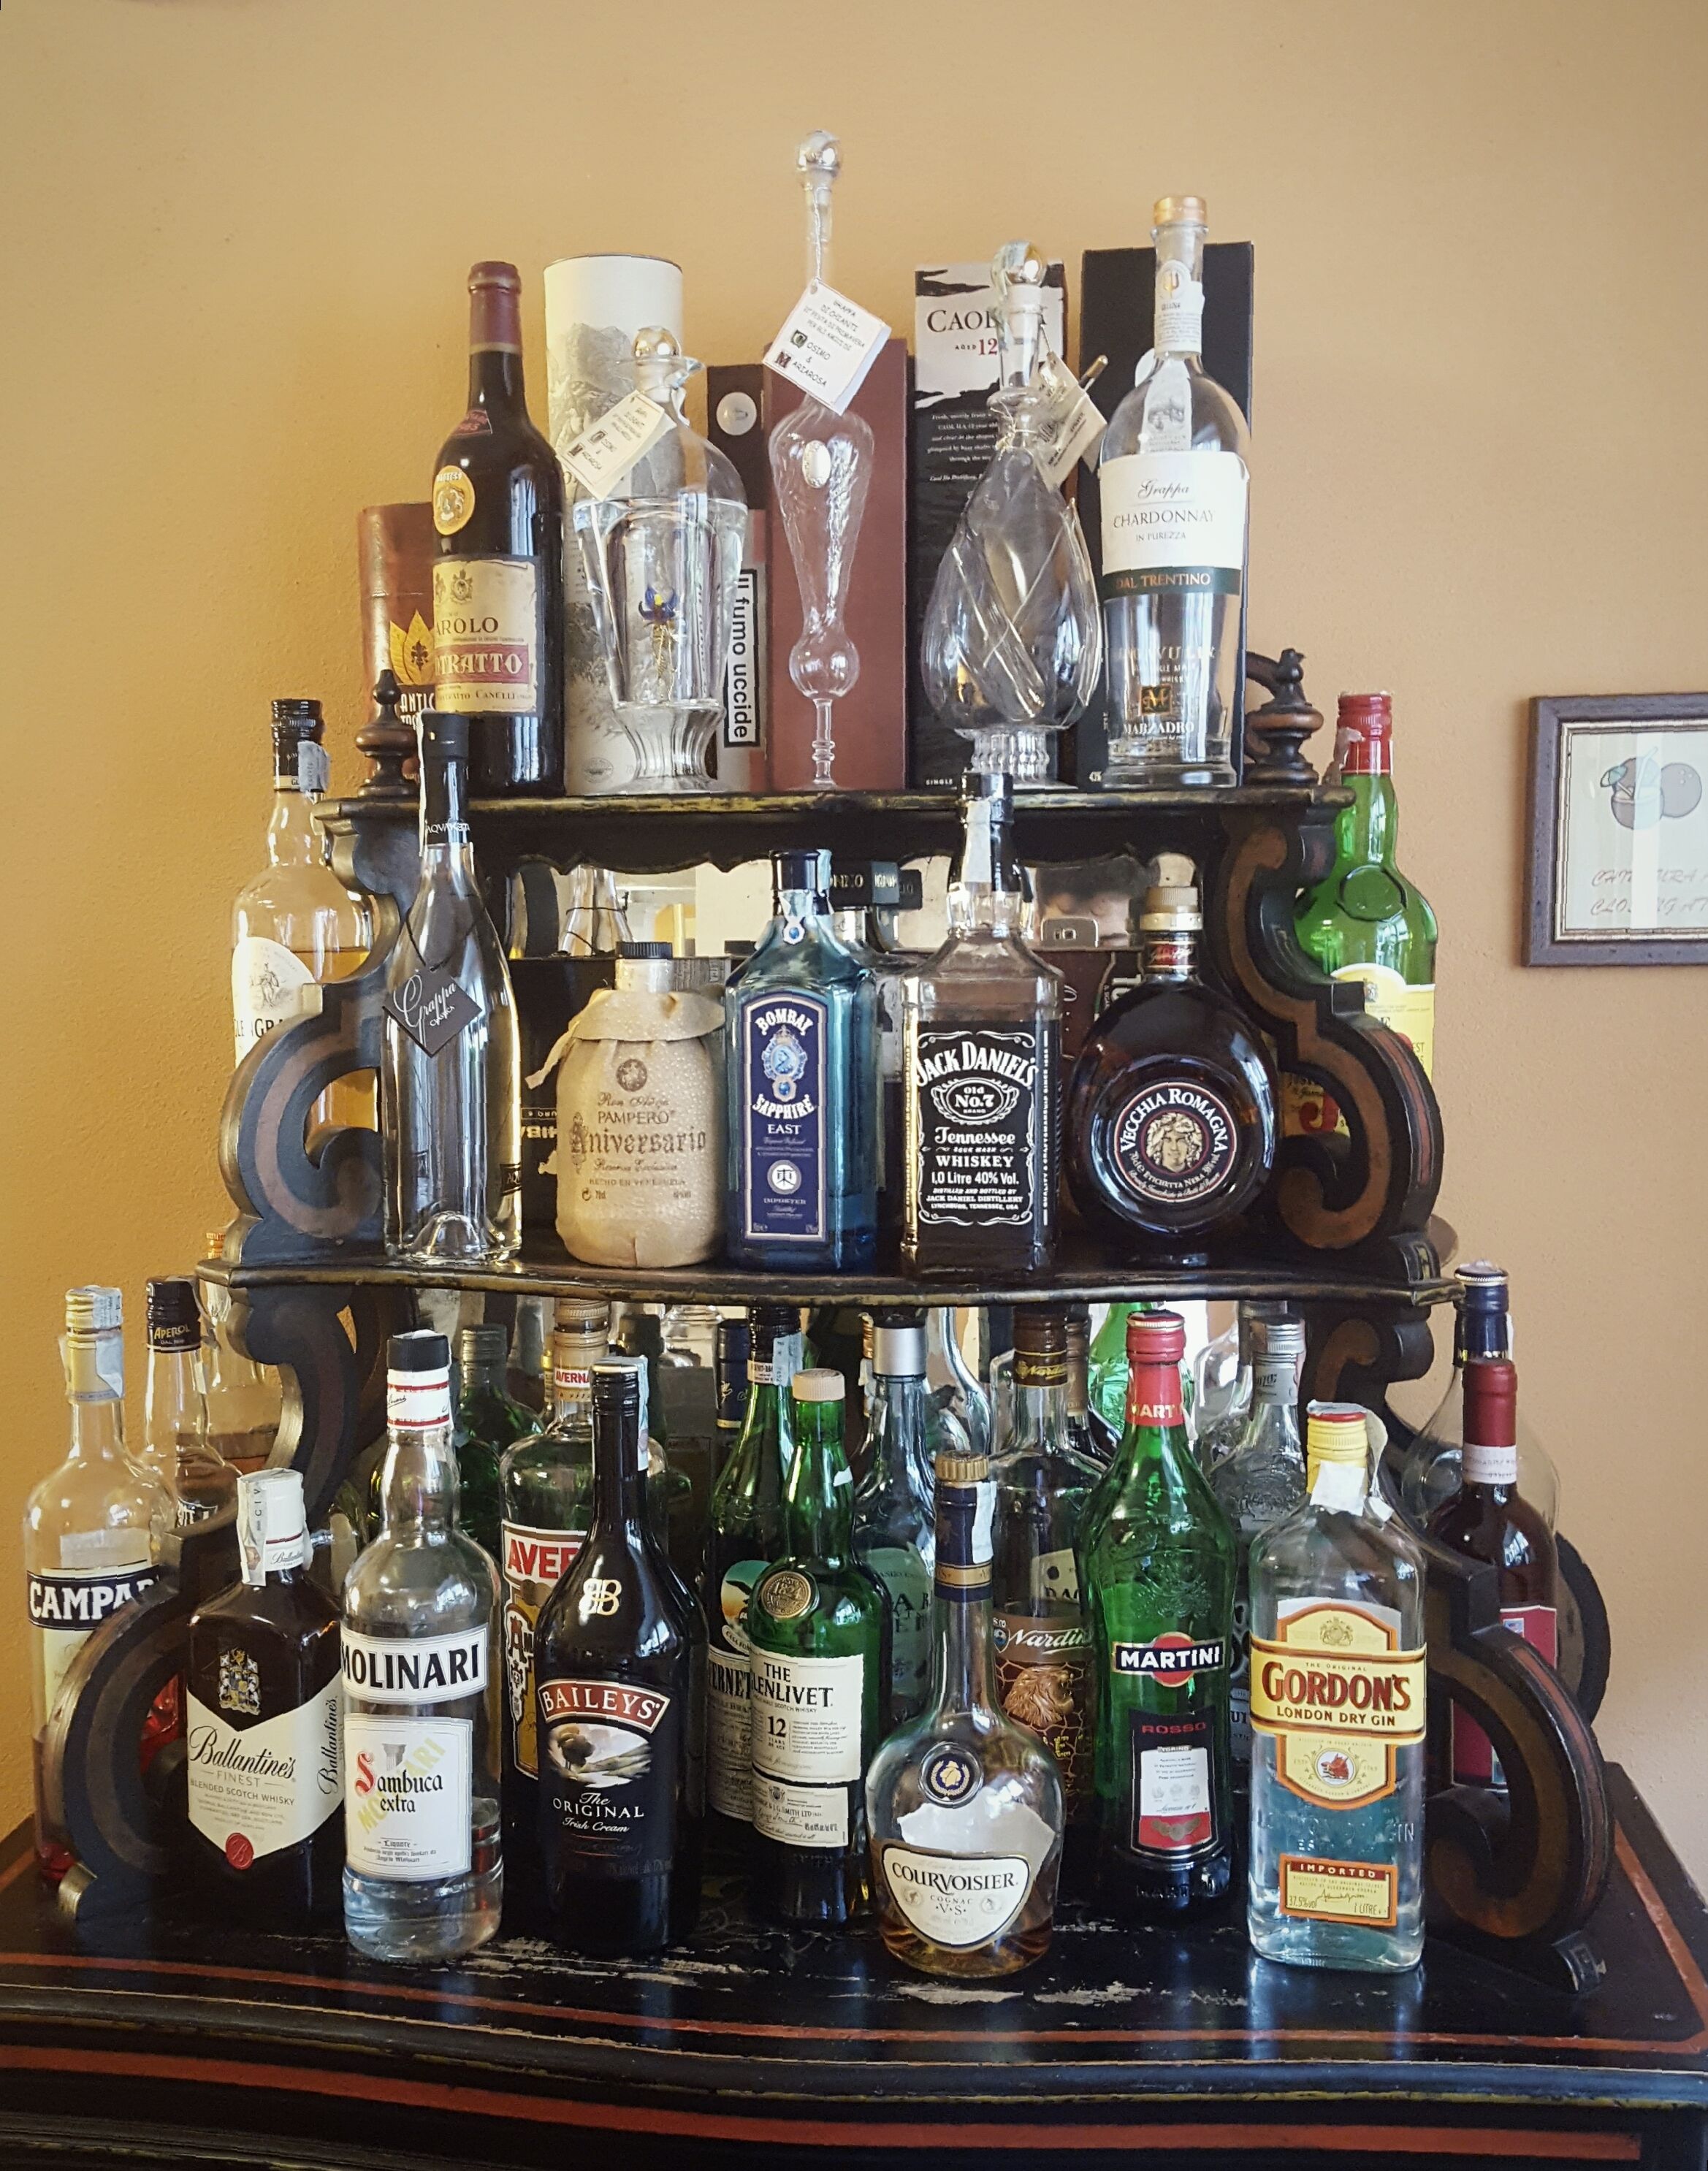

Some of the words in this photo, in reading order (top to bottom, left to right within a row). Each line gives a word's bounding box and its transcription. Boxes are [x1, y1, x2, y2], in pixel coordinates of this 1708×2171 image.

[978, 338, 998, 356] 12
[1137, 479, 1190, 499] Grappa
[1113, 510, 1215, 528] CHARDONNAY
[1140, 573, 1211, 587] TRENTINO
[732, 597, 750, 655] fumo
[436, 654, 523, 674] TRATTO
[400, 692, 436, 713] ANTIC
[733, 663, 752, 738] uccide
[755, 1008, 814, 1036] BOMBAY
[918, 1049, 961, 1087] JACK
[961, 1041, 1039, 1087] DANIEL'S
[964, 1086, 985, 1094] Old
[752, 1094, 816, 1120] SAPPHIRE
[598, 1110, 669, 1125] PAMPERO
[1121, 1093, 1167, 1153] VECCHIA
[1168, 1088, 1229, 1153] ROMAGNA
[767, 1123, 801, 1134] EAST
[934, 1126, 1016, 1145] Tennessee
[936, 1155, 1014, 1168] WHISKEY
[948, 1171, 972, 1185] Litre
[975, 1172, 999, 1185] 40%
[1000, 1172, 1020, 1185] Vol.
[1183, 1173, 1205, 1187] NERA
[153, 1324, 191, 1340] APEROL
[29, 1574, 159, 1621] CAMPA
[341, 1641, 479, 1690] MOLINARI
[1121, 1646, 1221, 1669] MARTINI
[1326, 1663, 1368, 1671] ORIGINAL
[763, 1662, 791, 1683] THE
[751, 1673, 834, 1708] LENLIVET
[1262, 1661, 1411, 1712] GORDON'S
[542, 1687, 656, 1720] BAILEYS
[1277, 1706, 1333, 1722] LONDON
[1339, 1712, 1366, 1725] DRY
[1371, 1714, 1395, 1726] GIN
[767, 1716, 787, 1738] 12
[1142, 1722, 1206, 1734] ROSSO
[188, 1725, 296, 1779] Ballantine's
[317, 1697, 339, 1796] Ballantine's
[216, 1770, 261, 1787] FINEST
[355, 1751, 443, 1795] Sambuca
[190, 1778, 224, 1793] BLENDED
[226, 1787, 259, 1801] SCOTCH
[261, 1794, 295, 1806] WHISKY
[579, 1792, 611, 1806] The
[380, 1794, 416, 1813] extra
[553, 1798, 644, 1819] ORIGINAL
[563, 1817, 590, 1831] Irish
[592, 1822, 630, 1833] Cream
[892, 1862, 1015, 1896] COURVOISIER
[1300, 1863, 1376, 1879] IMPORTED
[930, 1894, 973, 1904] COGNAC
